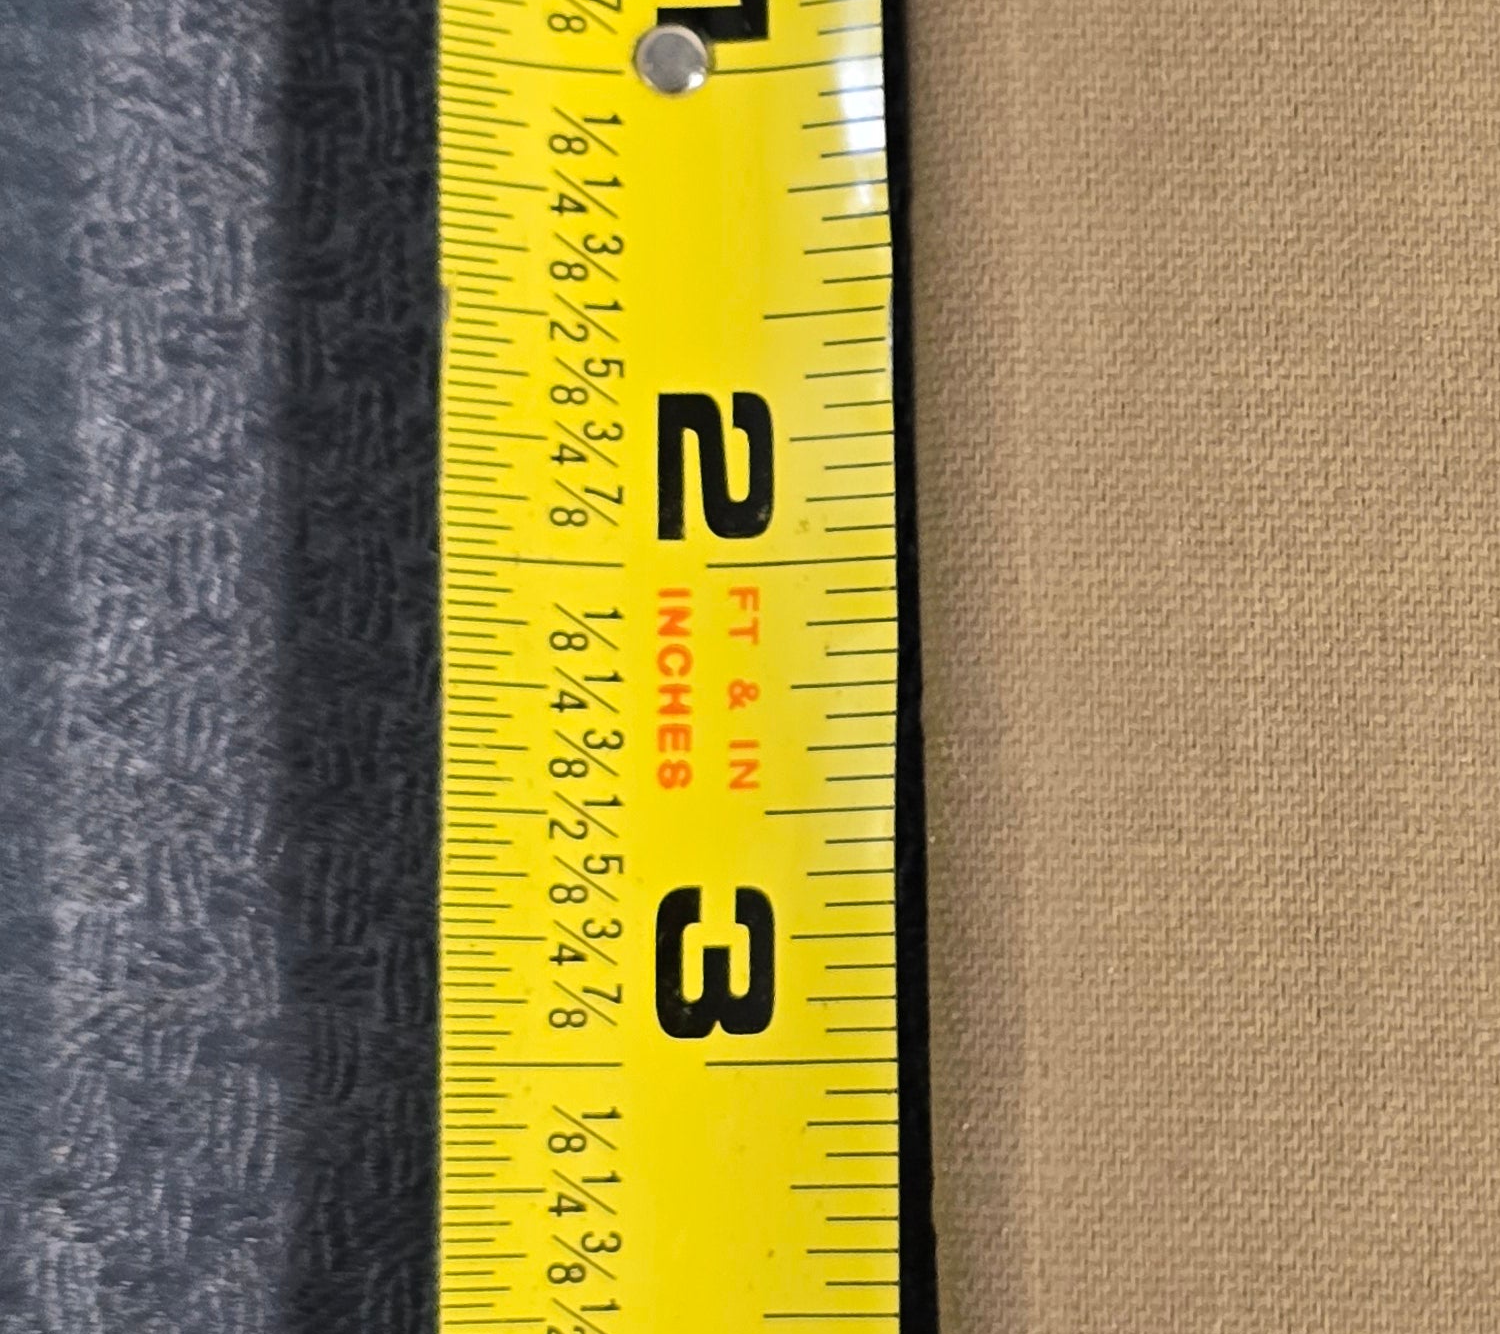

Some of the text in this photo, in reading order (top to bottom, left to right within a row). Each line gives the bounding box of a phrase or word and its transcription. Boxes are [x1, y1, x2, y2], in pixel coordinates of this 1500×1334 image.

[547, 107, 625, 527] 1/8 1/4 3/8 1/2 5/8 3/4 7/8
[657, 392, 774, 540] 2
[657, 588, 692, 790] INCHES
[728, 587, 760, 790] FT & IN
[548, 603, 624, 1029] 1/8 1/4 3/8 1/2 5/8 3/4 7/8
[656, 885, 775, 1039] 3
[547, 1105, 622, 1154] 1/8
[547, 1169, 622, 1217] 1/4
[546, 1231, 622, 1284] 3/8
